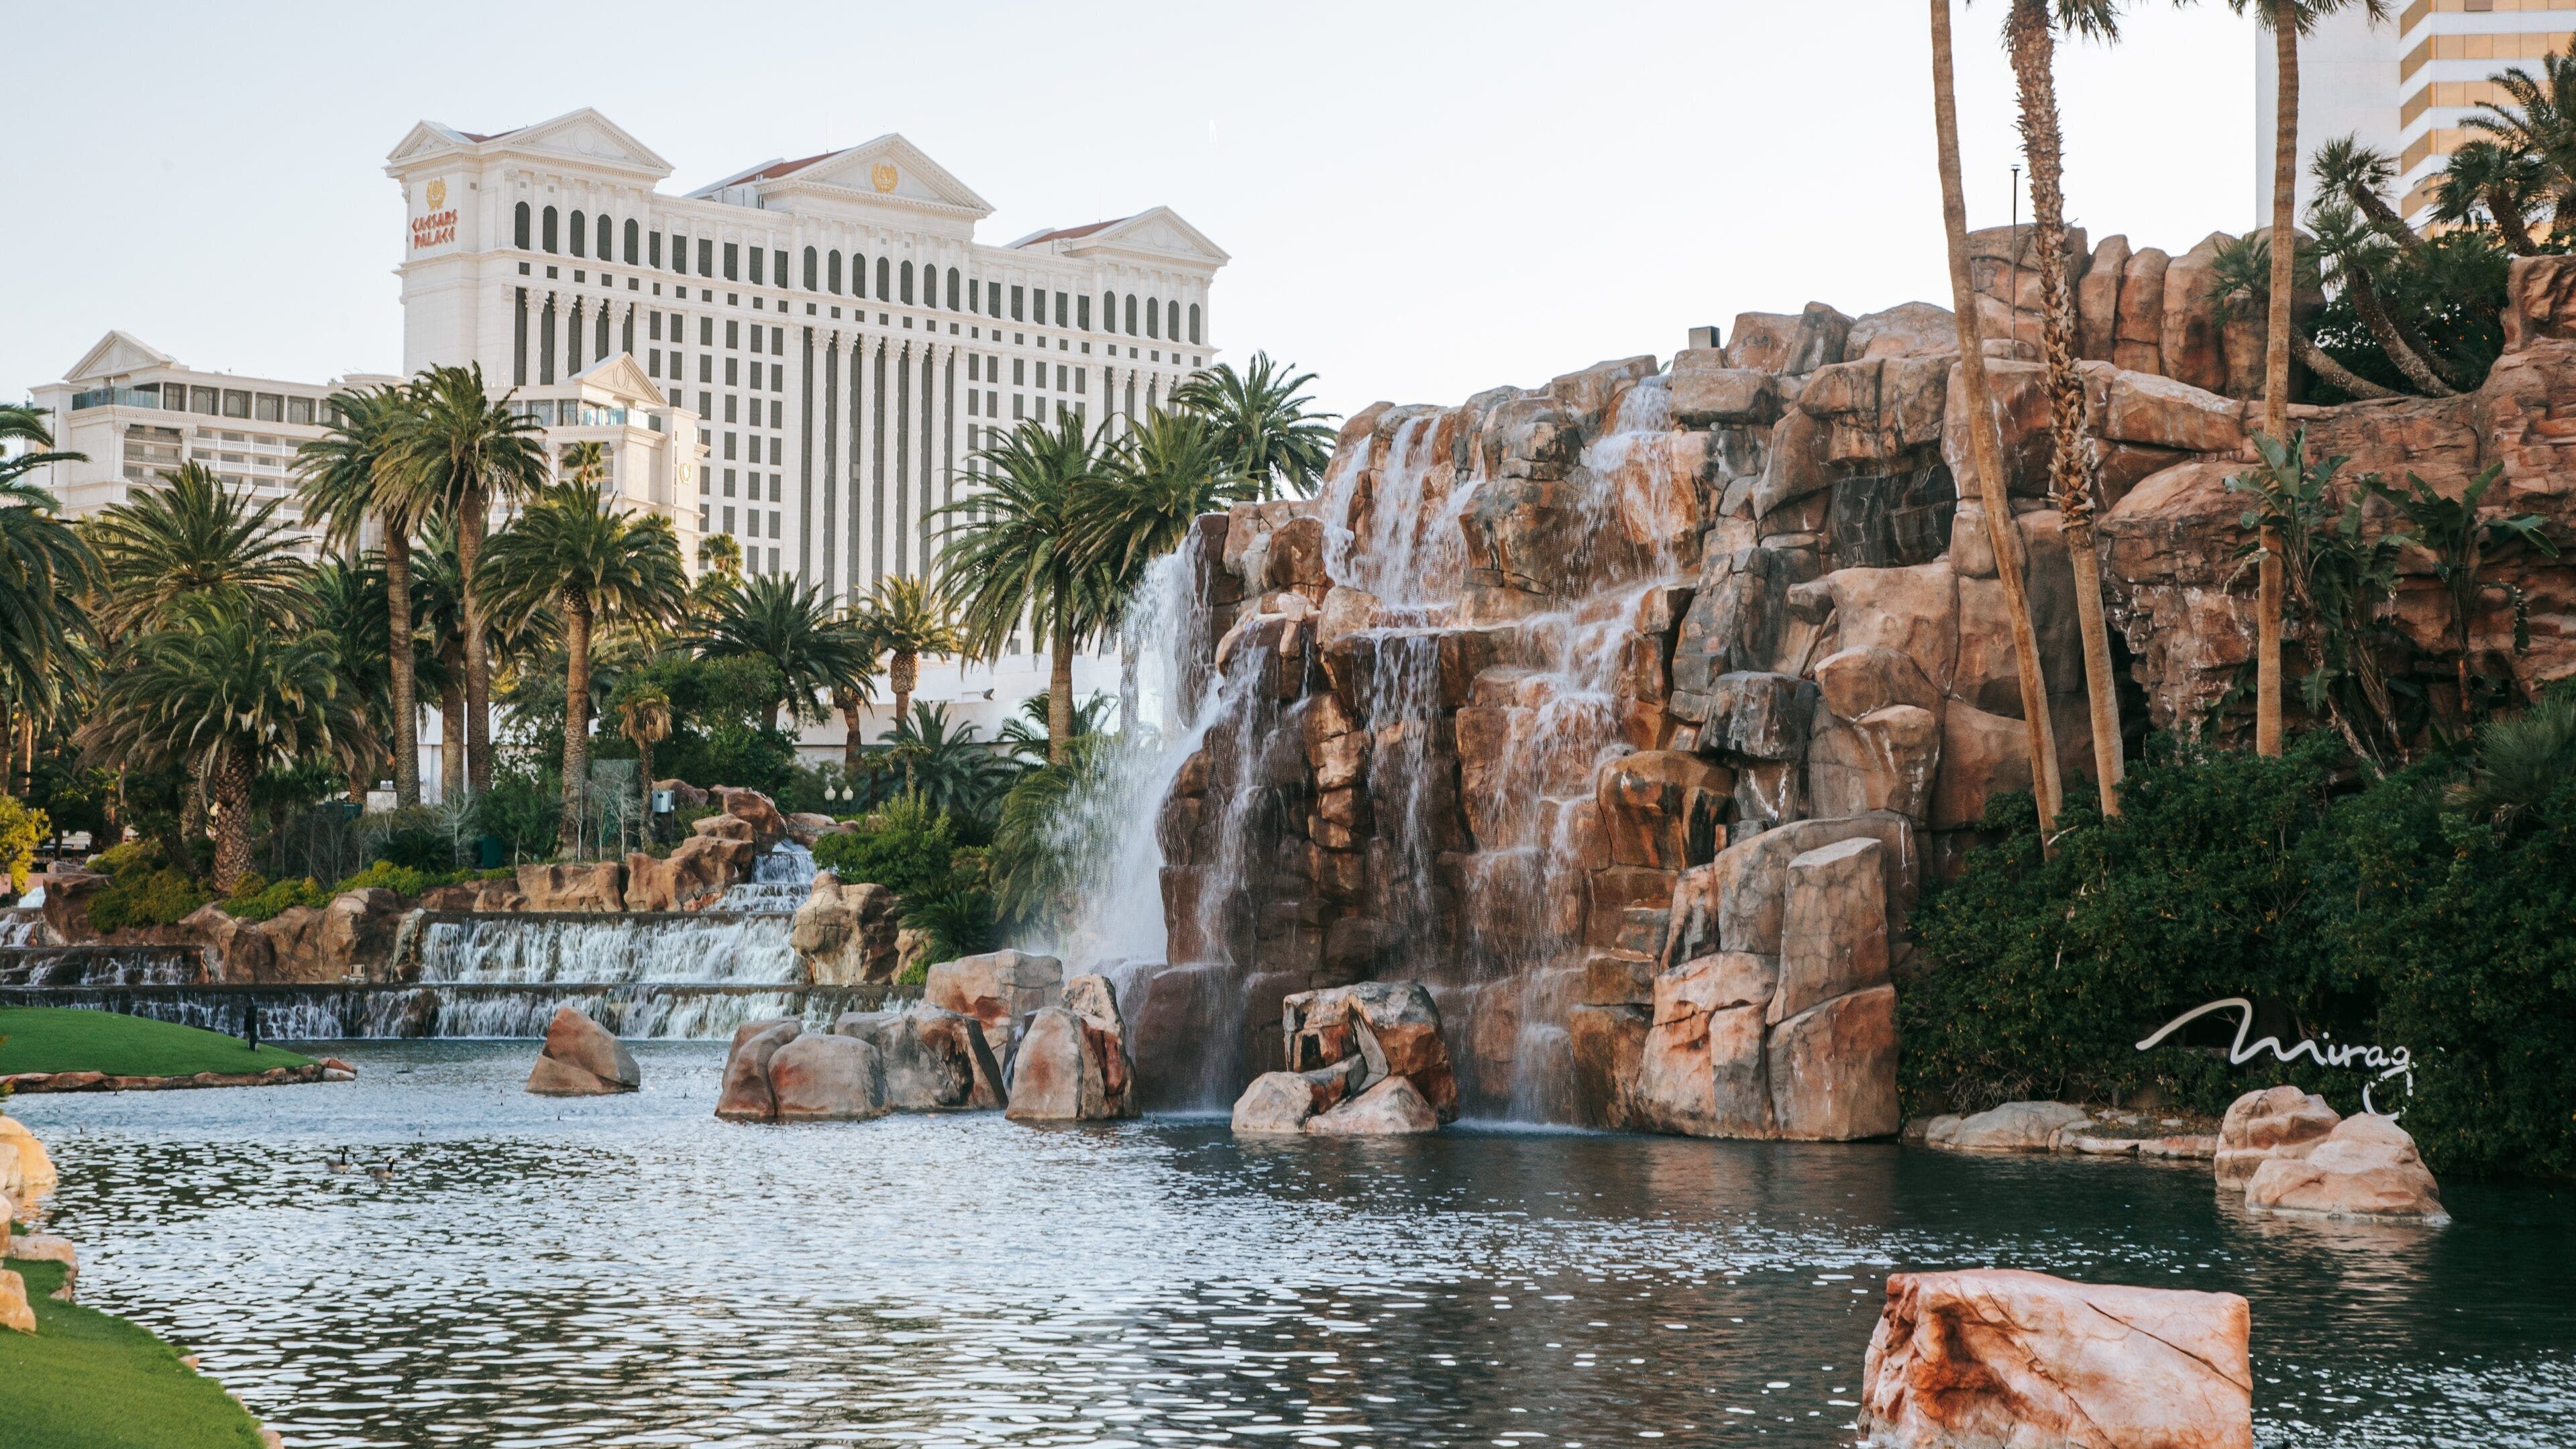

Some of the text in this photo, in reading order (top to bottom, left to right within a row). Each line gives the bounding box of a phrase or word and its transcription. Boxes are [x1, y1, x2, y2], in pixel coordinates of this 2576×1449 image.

[412, 209, 458, 233] CAESARS
[414, 226, 455, 250] PALACE
[2135, 998, 2445, 1121] Mirag
